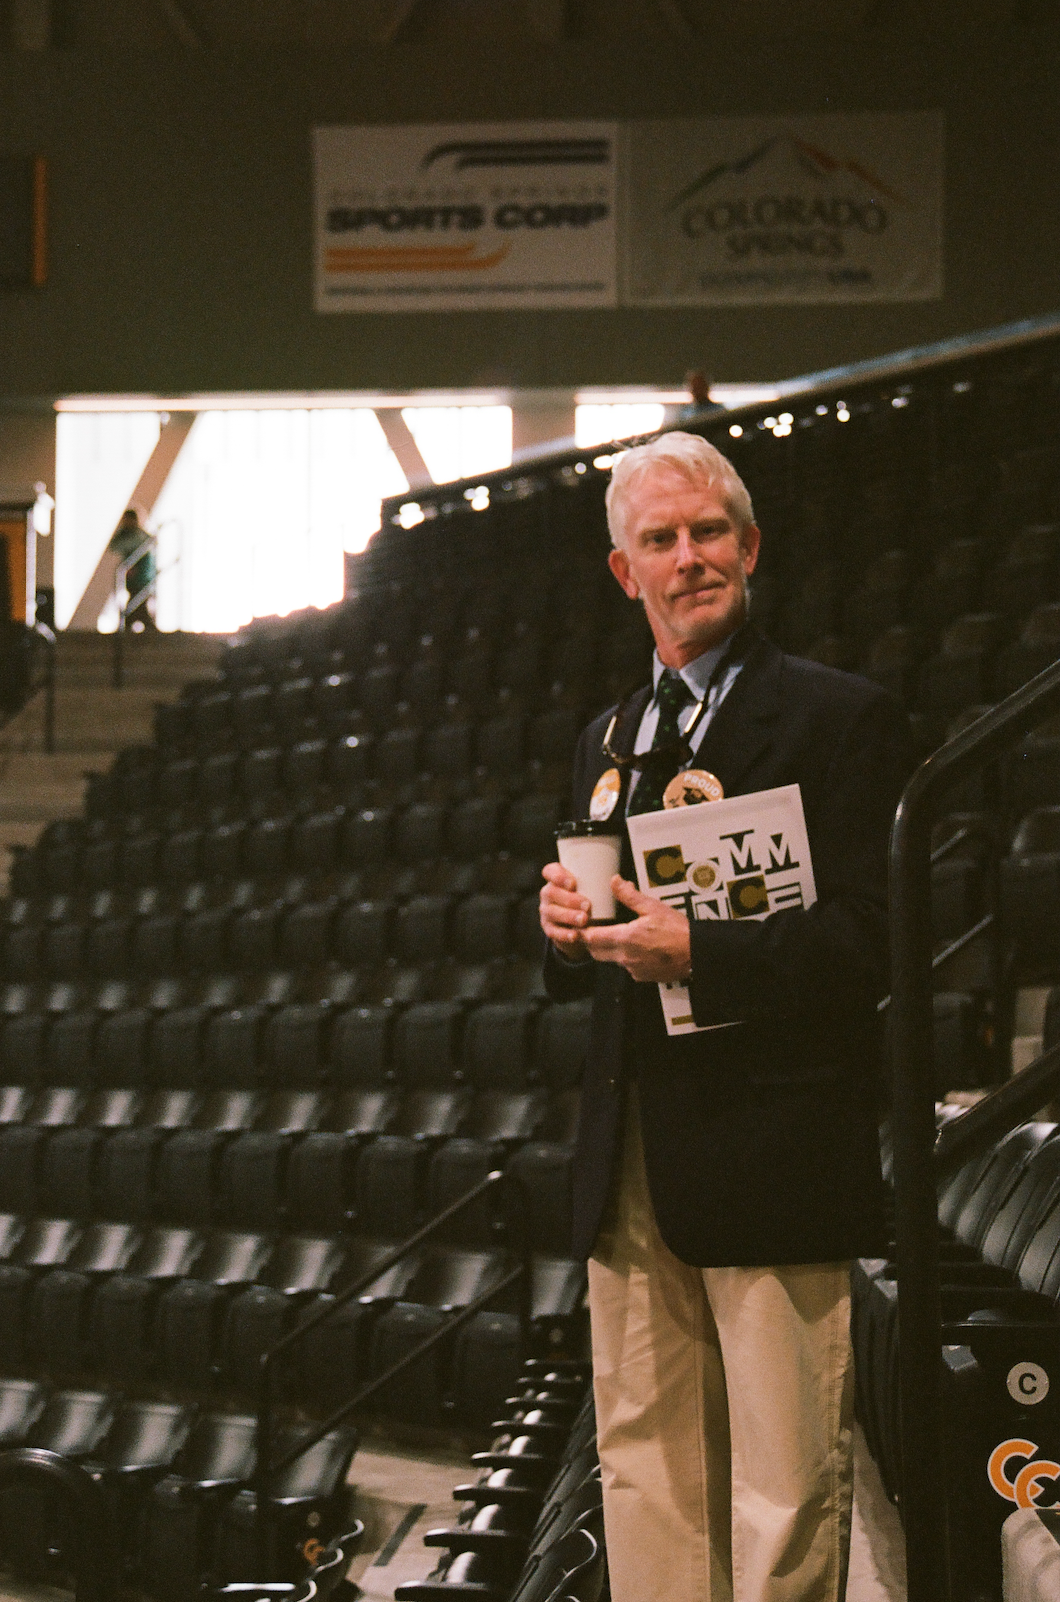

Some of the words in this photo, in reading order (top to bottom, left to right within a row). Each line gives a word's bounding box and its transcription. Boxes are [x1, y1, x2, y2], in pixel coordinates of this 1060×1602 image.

[326, 205, 484, 232] SPORTS
[494, 203, 610, 229] CORP
[681, 195, 888, 239] COLORADO
[725, 231, 845, 261] SPRINGS
[683, 773, 721, 797] PROUD
[1018, 1372, 1038, 1395] C
